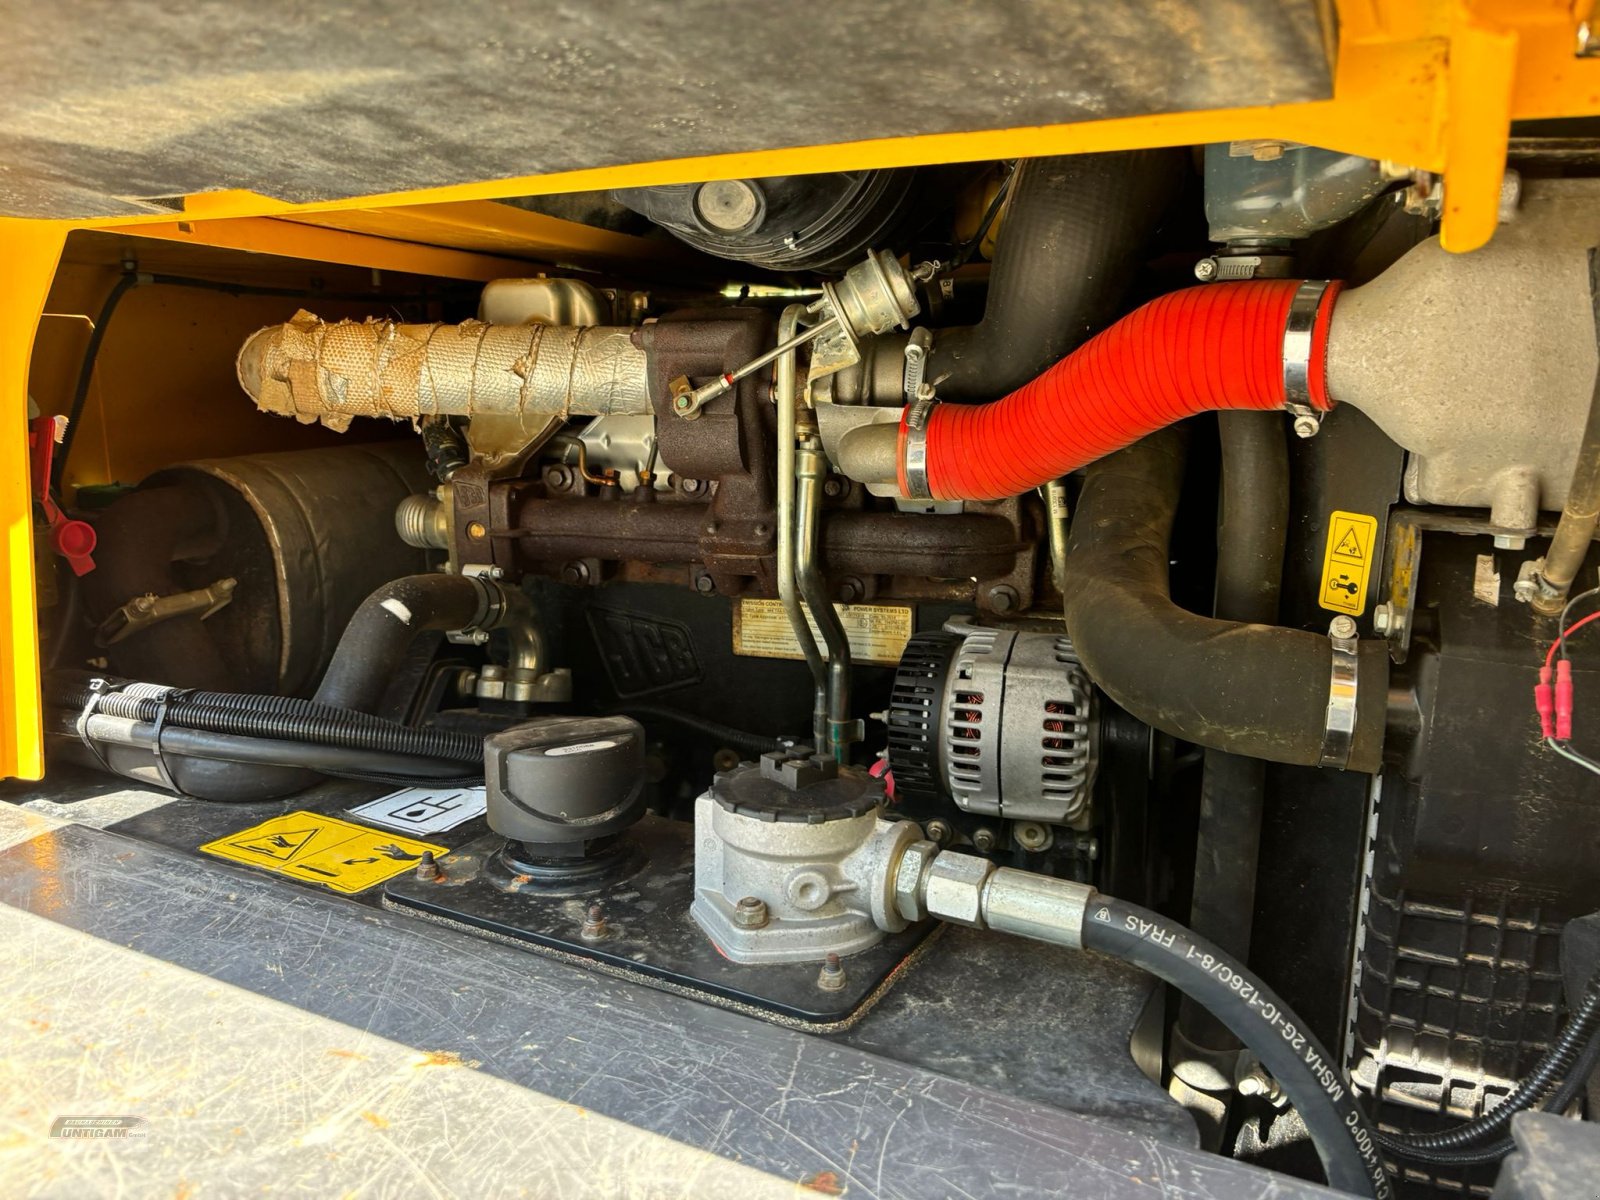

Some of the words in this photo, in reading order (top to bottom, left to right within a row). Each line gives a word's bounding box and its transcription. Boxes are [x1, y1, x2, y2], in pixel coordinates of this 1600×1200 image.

[603, 614, 692, 685] JCB
[1125, 915, 1176, 948] FRAS
[1186, 944, 1306, 1050] 2G-IC-126C/8-1
[1303, 1046, 1344, 1102] MSHA
